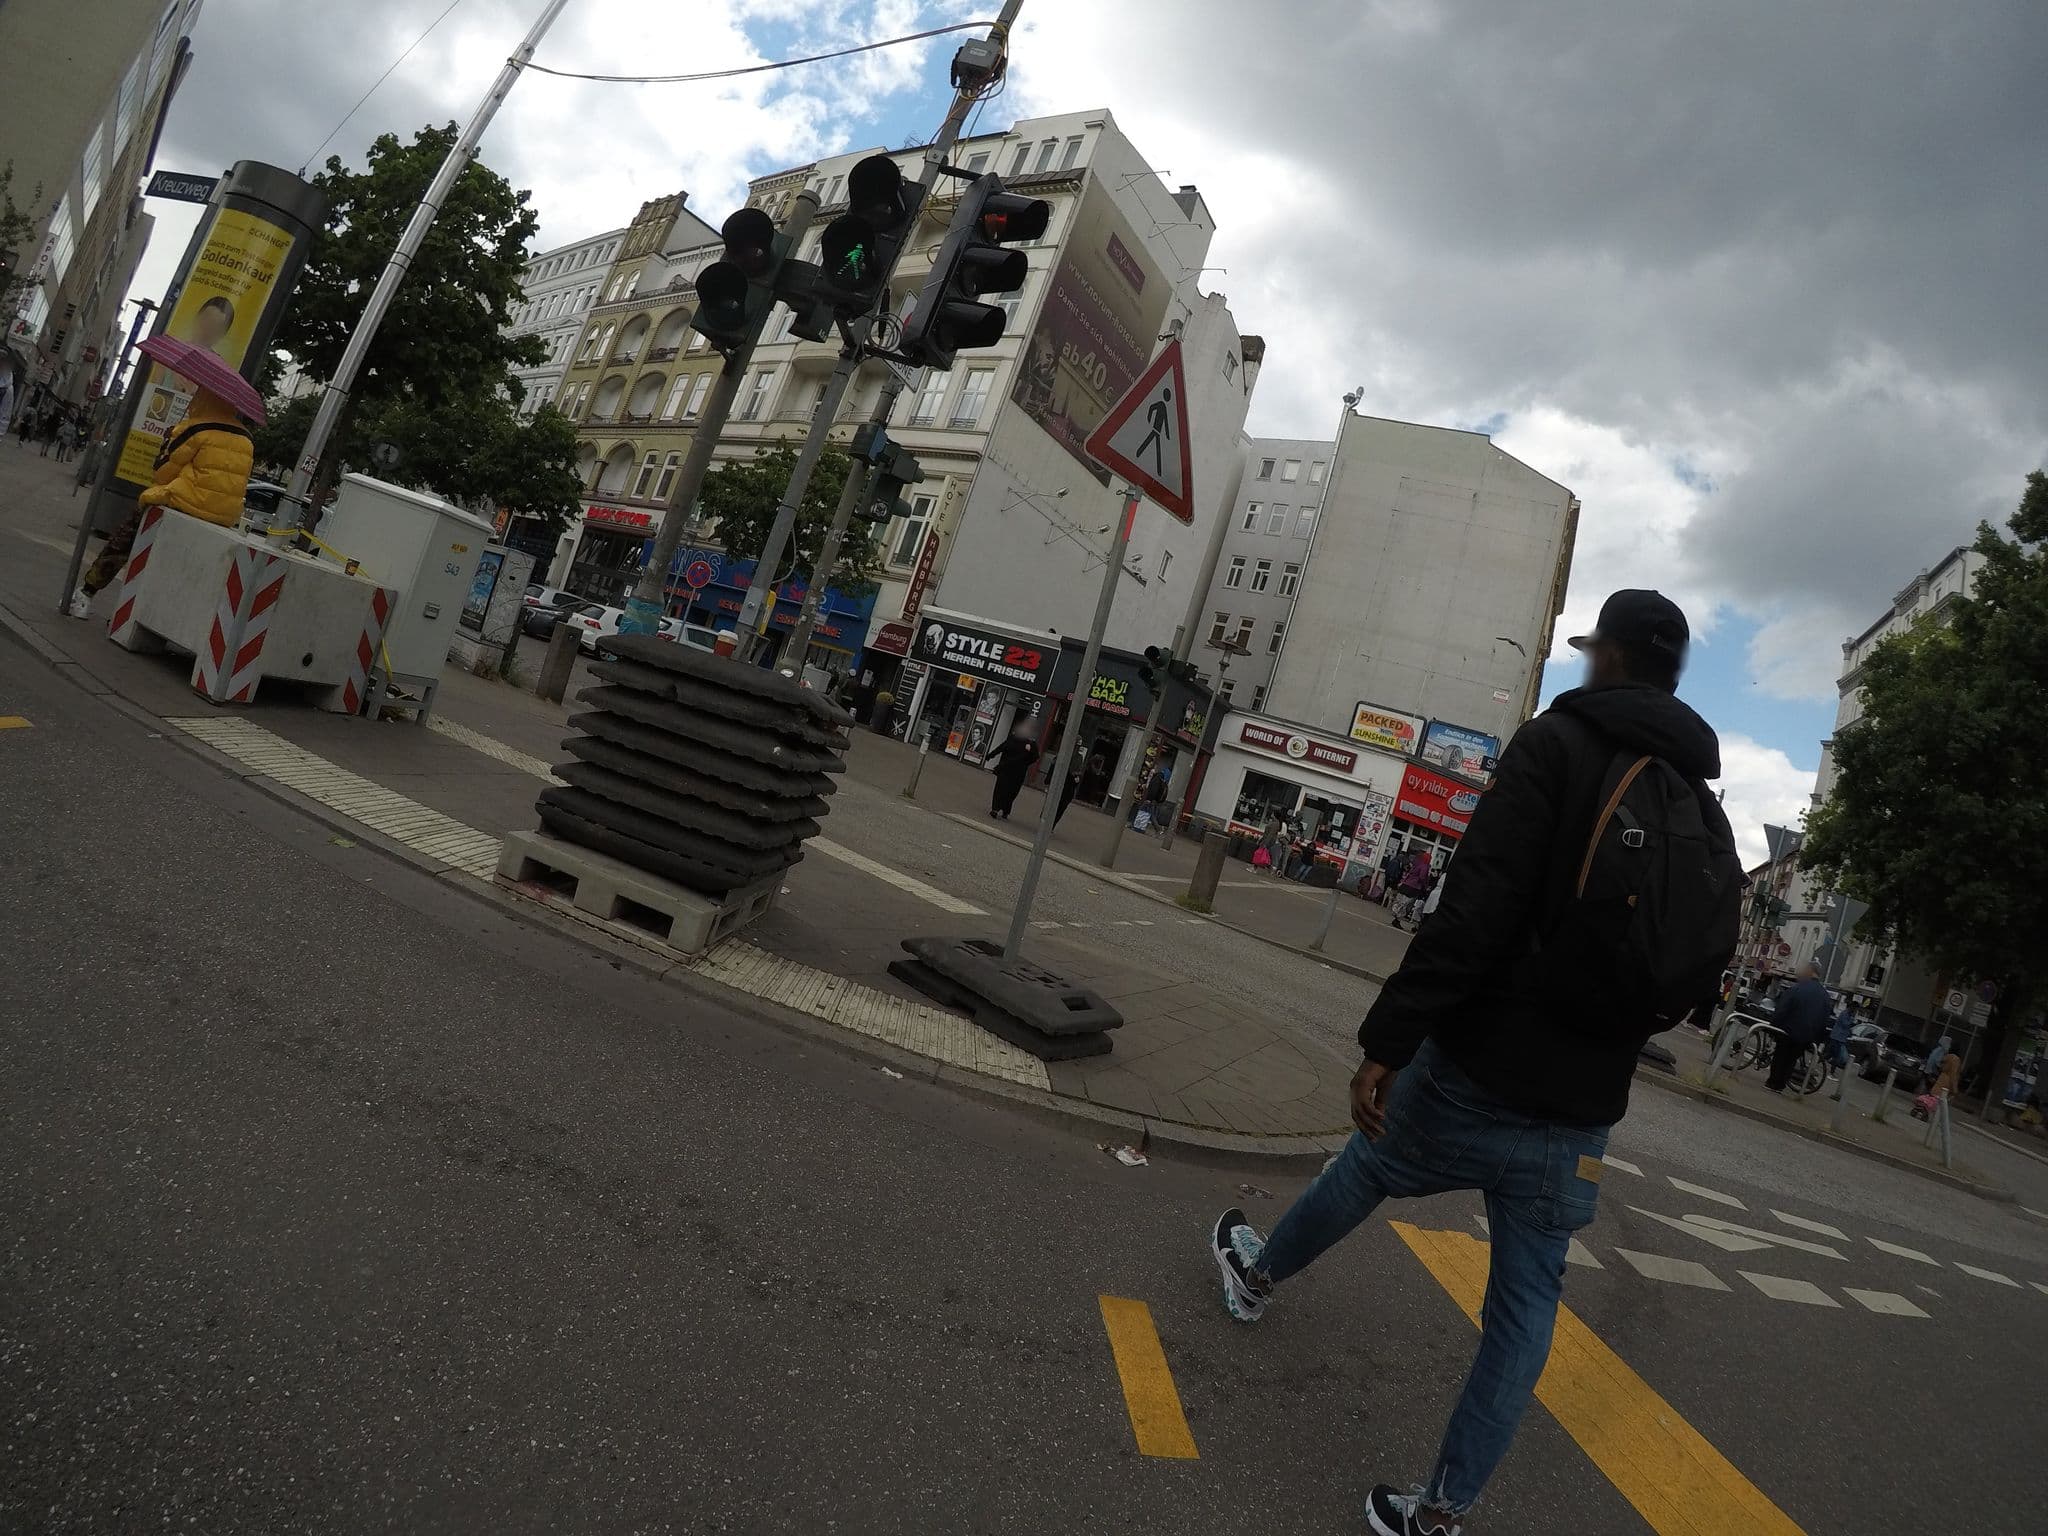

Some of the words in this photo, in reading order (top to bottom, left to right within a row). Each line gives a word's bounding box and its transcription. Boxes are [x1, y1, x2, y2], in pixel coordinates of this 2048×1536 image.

[152, 174, 210, 201] Kreuzweg
[201, 249, 274, 285] Goldankauf
[1057, 285, 1079, 317] Damit
[1078, 311, 1091, 330] Sie
[1090, 325, 1104, 345] sich
[1066, 260, 1145, 361] www.novum-hotels.de
[1062, 341, 1080, 366] ab
[1080, 350, 1107, 391] 40
[935, 480, 958, 533] HOTEL
[905, 539, 938, 613] HAMBURG
[879, 630, 908, 646] Hamburg
[945, 632, 1005, 662] STYLE
[1003, 645, 1042, 671] 23
[942, 650, 986, 670] HERREN
[986, 661, 1037, 684] FRISEUR
[1090, 685, 1126, 706] BABA
[1095, 675, 1130, 696] HAJI
[1353, 728, 1396, 746] SUNSHINE
[1359, 711, 1404, 731] PACKED
[1244, 727, 1278, 744] WORLD
[1277, 735, 1291, 747] OF
[1312, 747, 1352, 766] INTERNET
